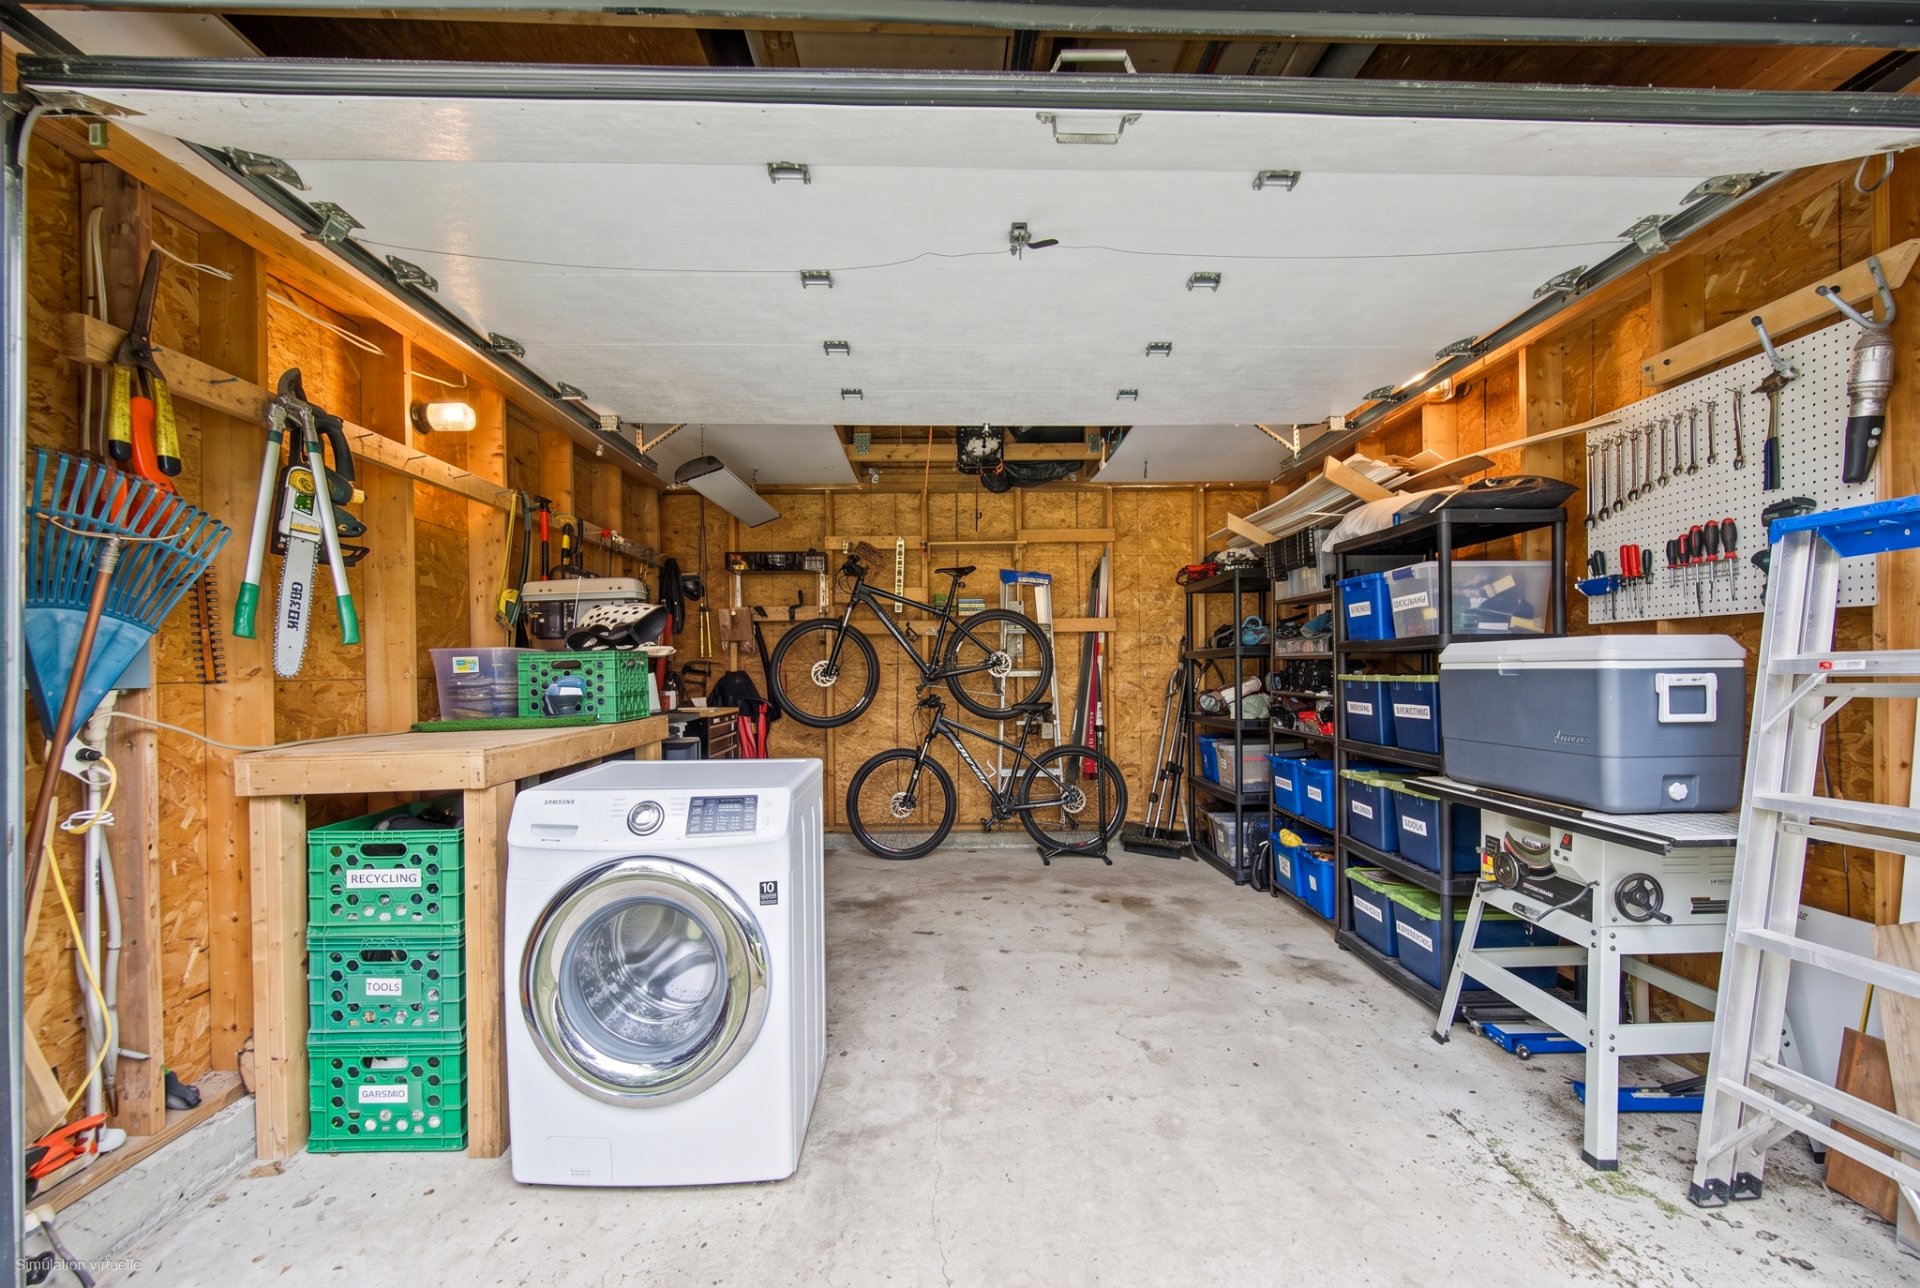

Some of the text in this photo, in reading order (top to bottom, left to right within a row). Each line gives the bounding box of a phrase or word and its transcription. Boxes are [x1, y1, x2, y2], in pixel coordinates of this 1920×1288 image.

[351, 873, 417, 884] RECYCLING
[761, 882, 775, 893] 10
[367, 982, 400, 992] TOOLS
